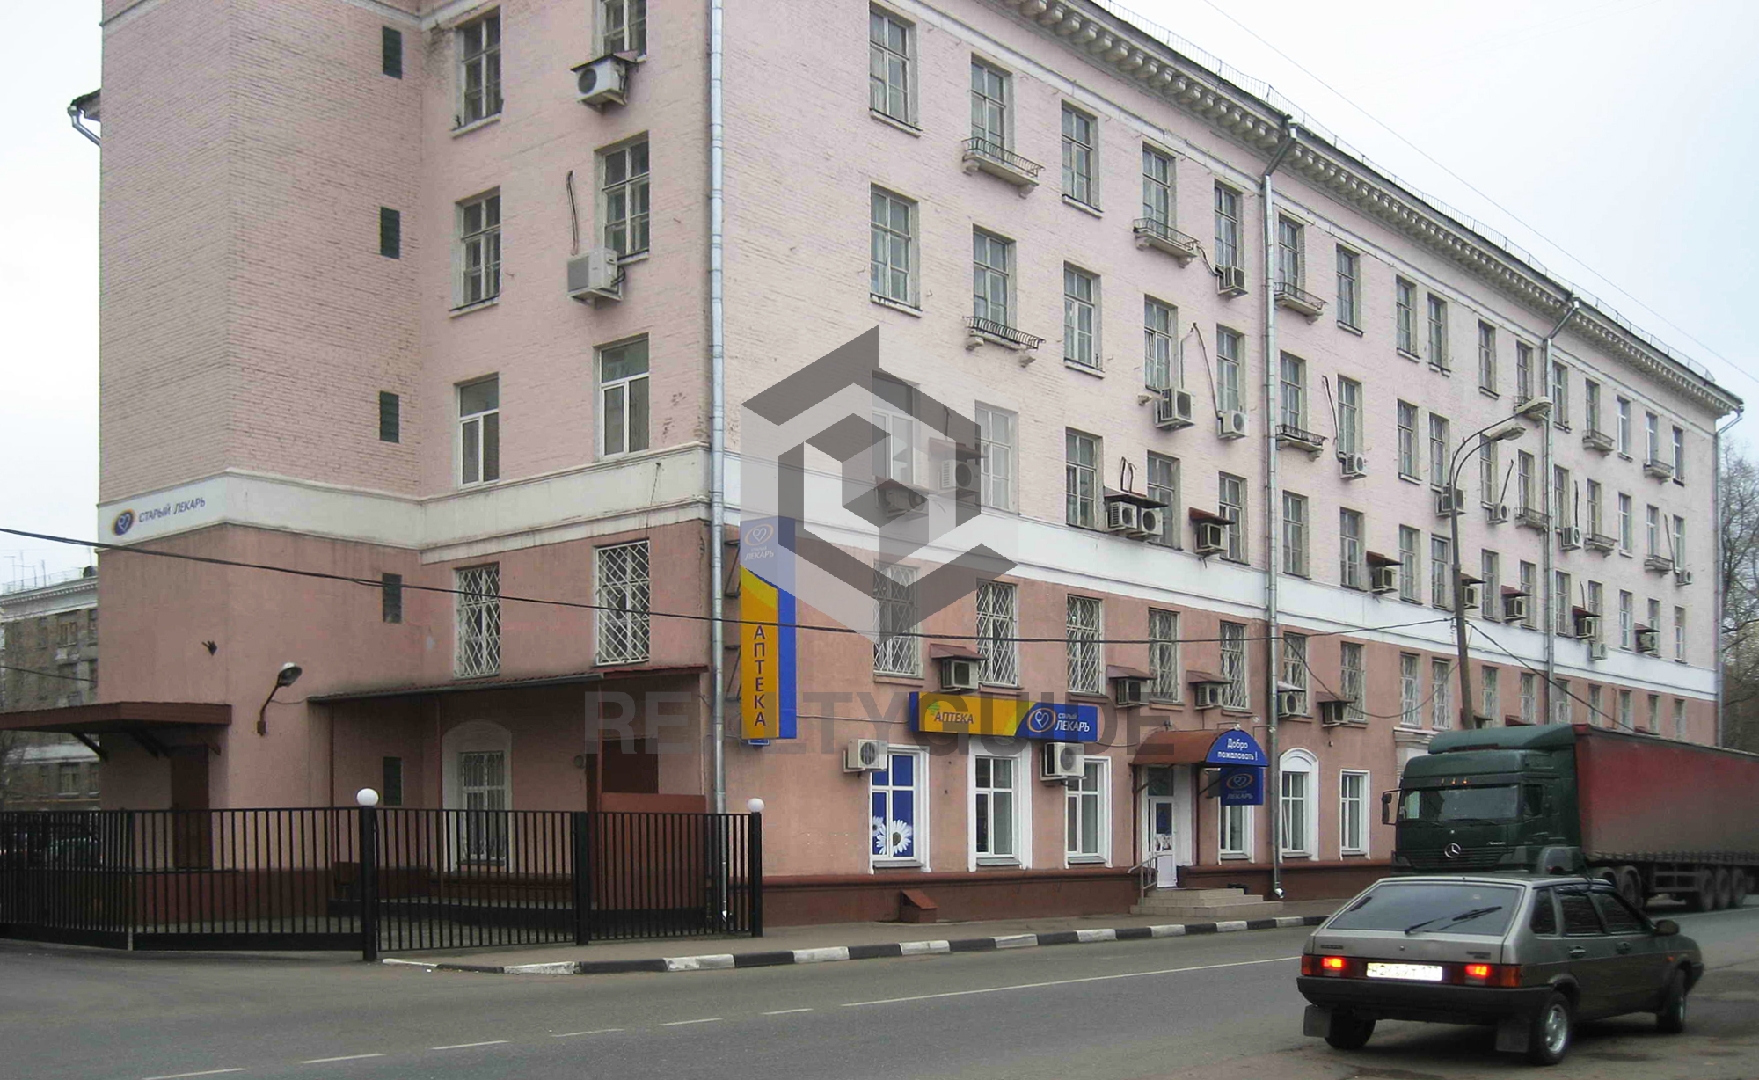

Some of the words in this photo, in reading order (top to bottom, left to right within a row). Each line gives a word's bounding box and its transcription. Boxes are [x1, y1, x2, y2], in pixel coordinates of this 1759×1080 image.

[138, 503, 171, 523] СТАРЫЙ
[173, 497, 206, 515] ЛЕКАРЬ
[753, 625, 767, 727] АПТЕКА
[934, 711, 974, 724] АПТЕКА
[1055, 719, 1090, 732] ЛЕКАРЬ
[1227, 738, 1249, 751] Добро
